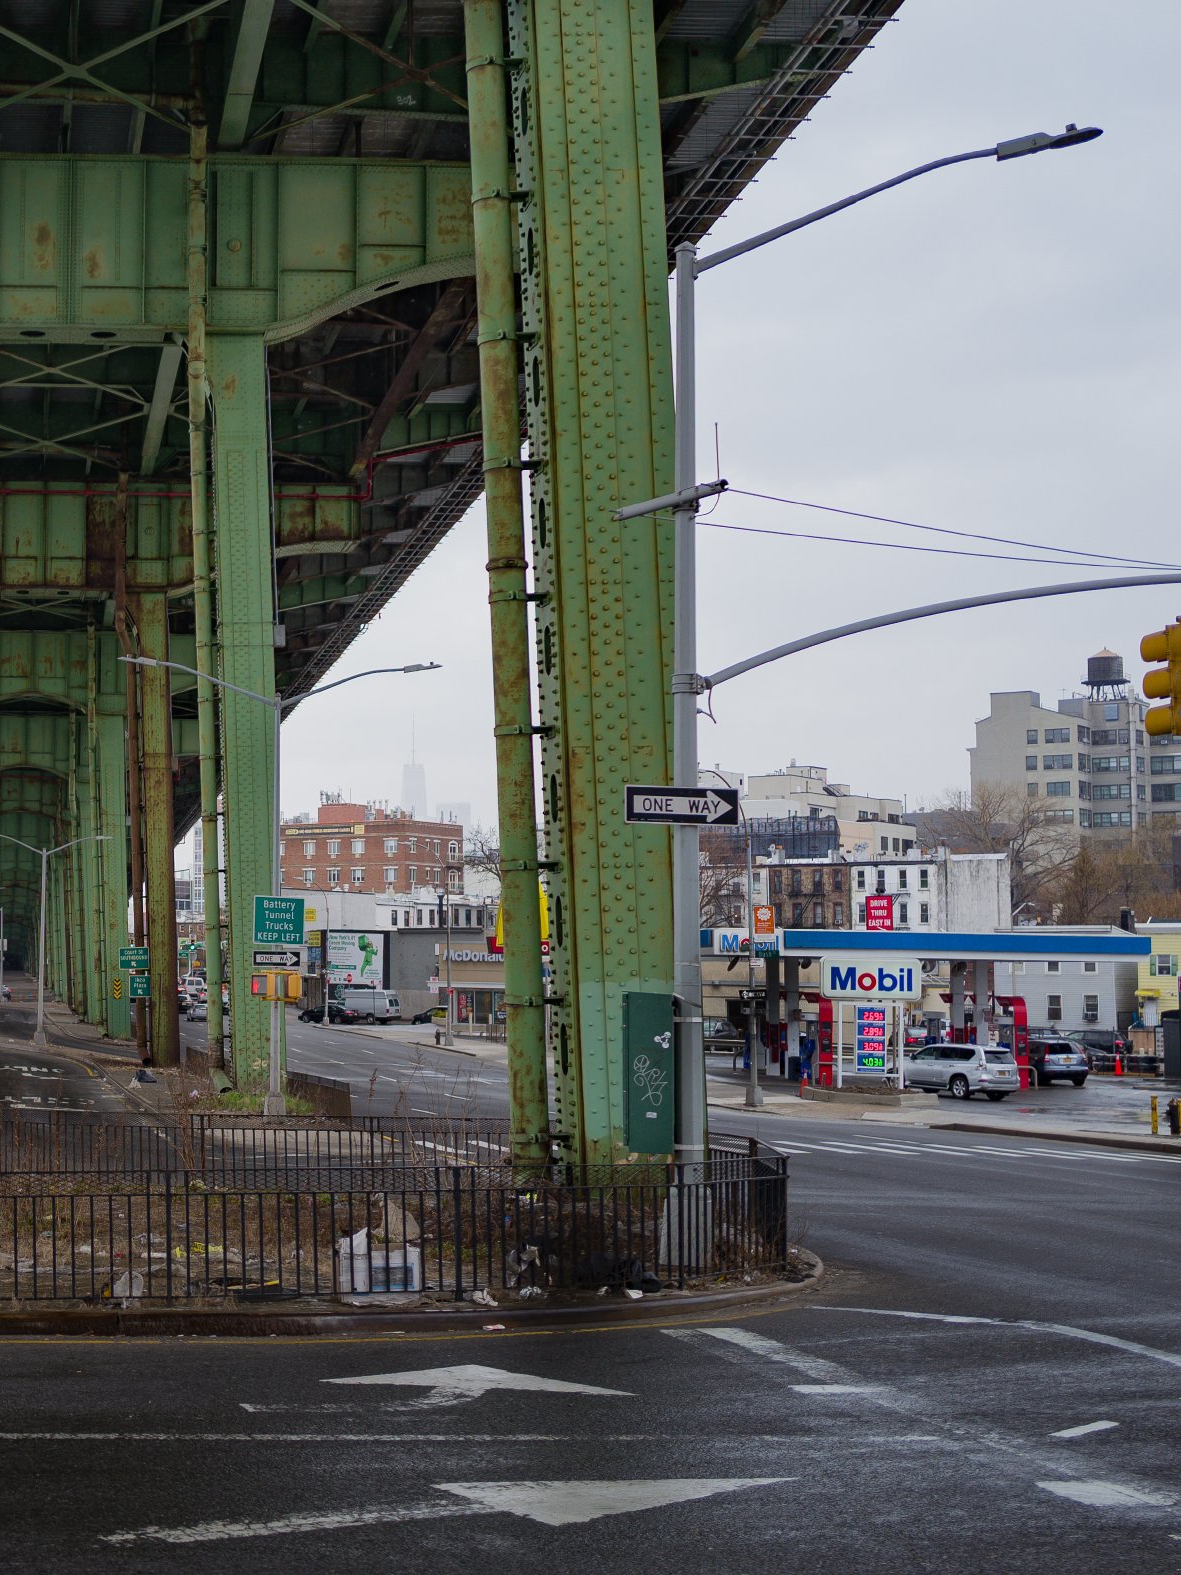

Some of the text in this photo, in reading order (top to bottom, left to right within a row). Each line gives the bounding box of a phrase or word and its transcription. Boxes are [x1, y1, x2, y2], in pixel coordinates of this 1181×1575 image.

[642, 797, 721, 814] ONE WAY
[263, 899, 296, 911] Battery
[869, 899, 888, 908] DRIVE
[264, 911, 295, 920] Tunnel
[870, 909, 888, 917] THRU
[265, 921, 294, 931] Trucks
[868, 918, 891, 927] EASY IN
[257, 932, 278, 941] KEEP
[281, 933, 300, 941] LEFT
[830, 966, 913, 992] Mobil
